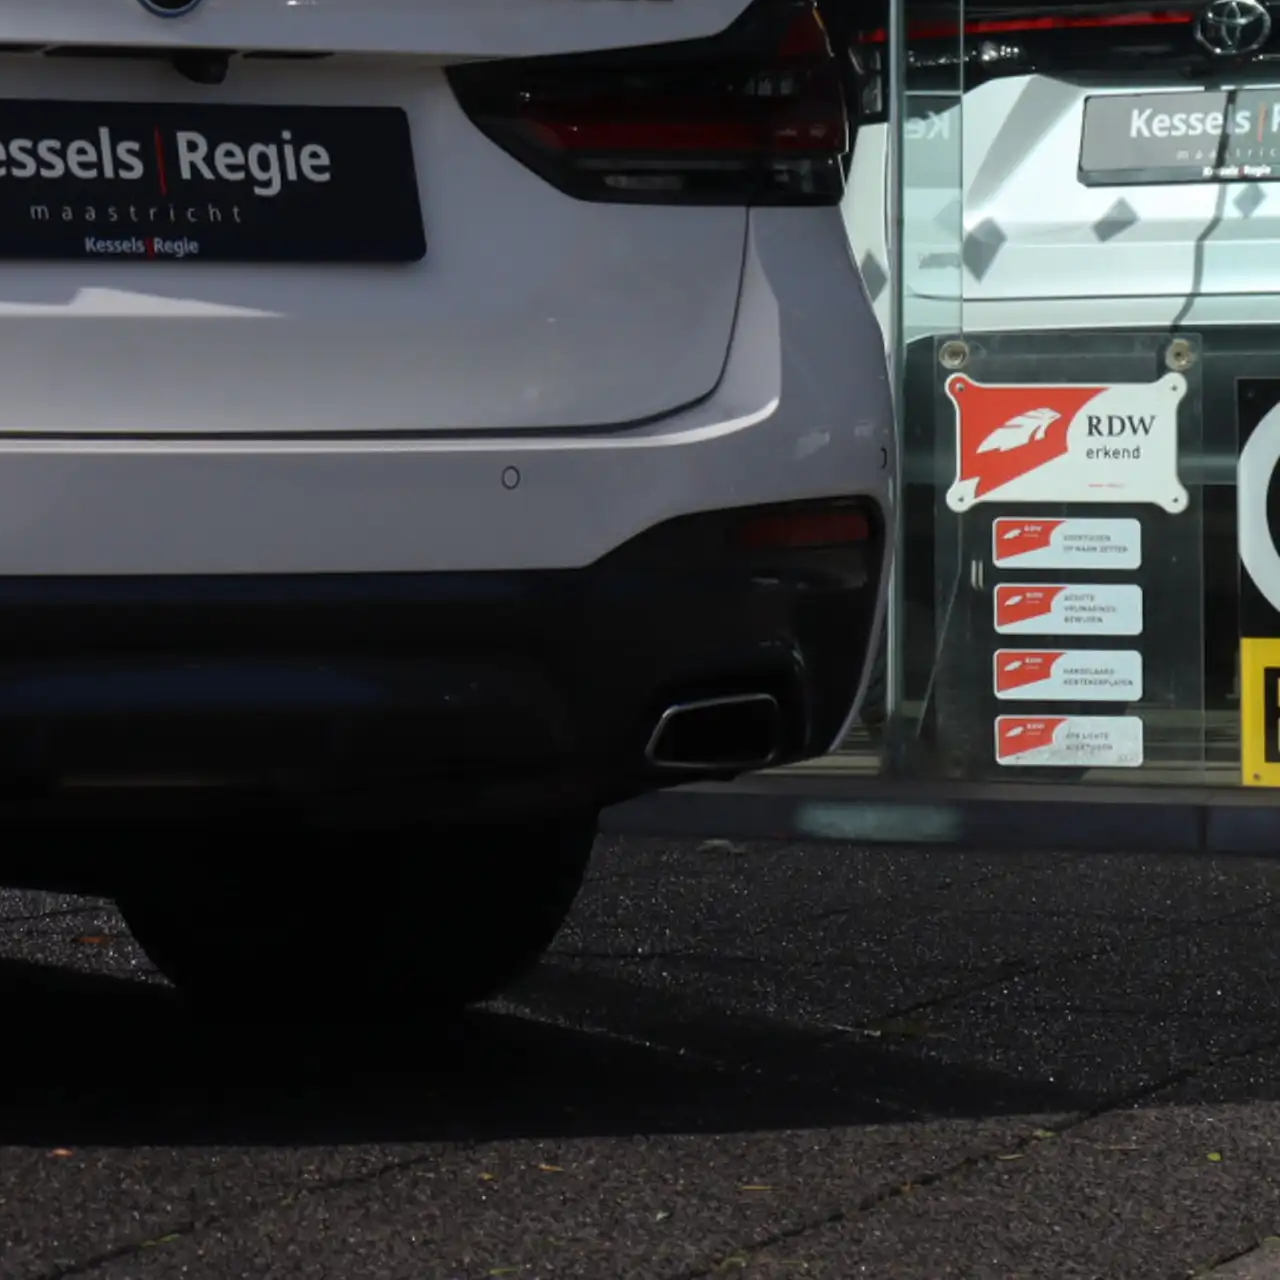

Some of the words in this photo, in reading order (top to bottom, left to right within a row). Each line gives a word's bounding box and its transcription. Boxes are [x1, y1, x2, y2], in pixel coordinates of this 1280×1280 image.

[176, 130, 332, 197] Regie
[30, 203, 242, 224] maastricht
[84, 235, 146, 254] Kessels
[153, 236, 200, 257] Regie
[1086, 414, 1158, 437] RDW
[1086, 444, 1142, 460] erkend
